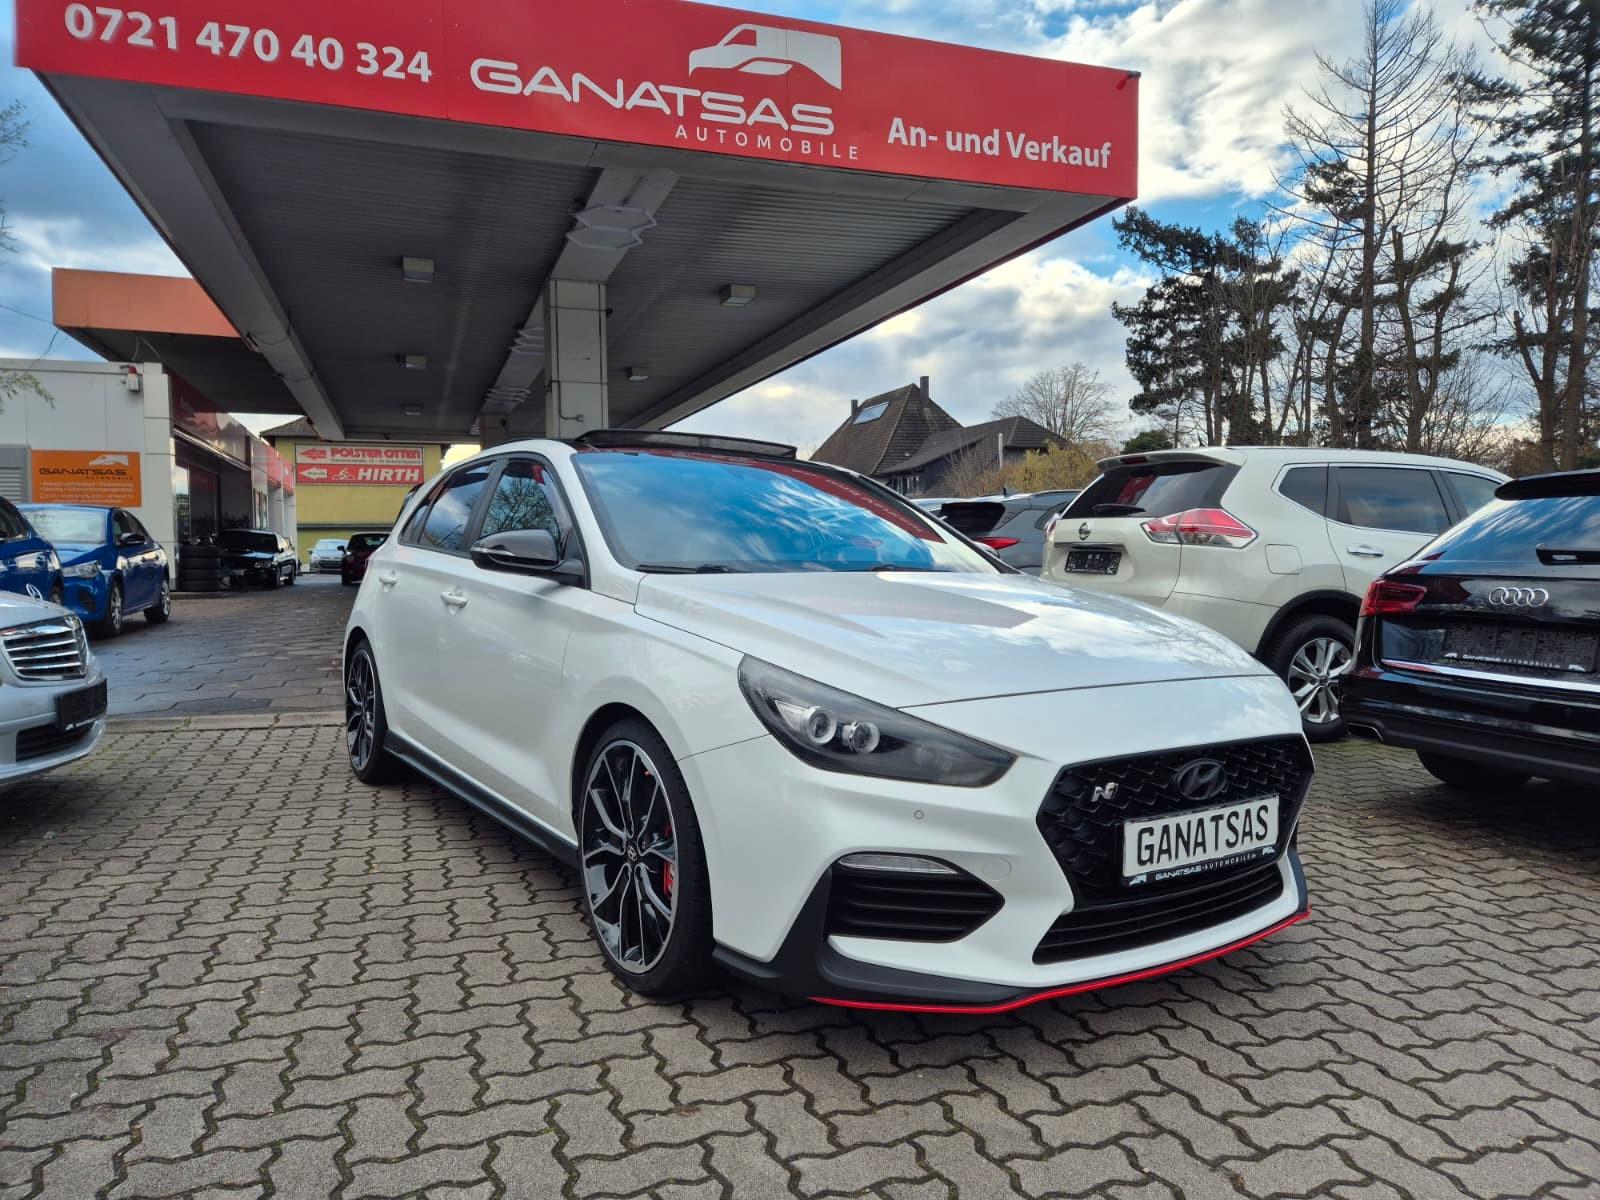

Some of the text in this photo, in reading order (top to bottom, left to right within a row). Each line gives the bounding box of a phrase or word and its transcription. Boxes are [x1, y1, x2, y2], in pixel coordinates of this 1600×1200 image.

[64, 2, 432, 82] 0721 470 40 324
[470, 58, 835, 136] GANATSAS
[675, 125, 858, 161] AUTOMOBILE
[888, 117, 1111, 169] An- und Verkauf
[39, 467, 127, 476] GANATSAS
[330, 447, 382, 459] POLSTER
[358, 468, 419, 481] HIRTH
[1137, 804, 1269, 866] GANATSAS
